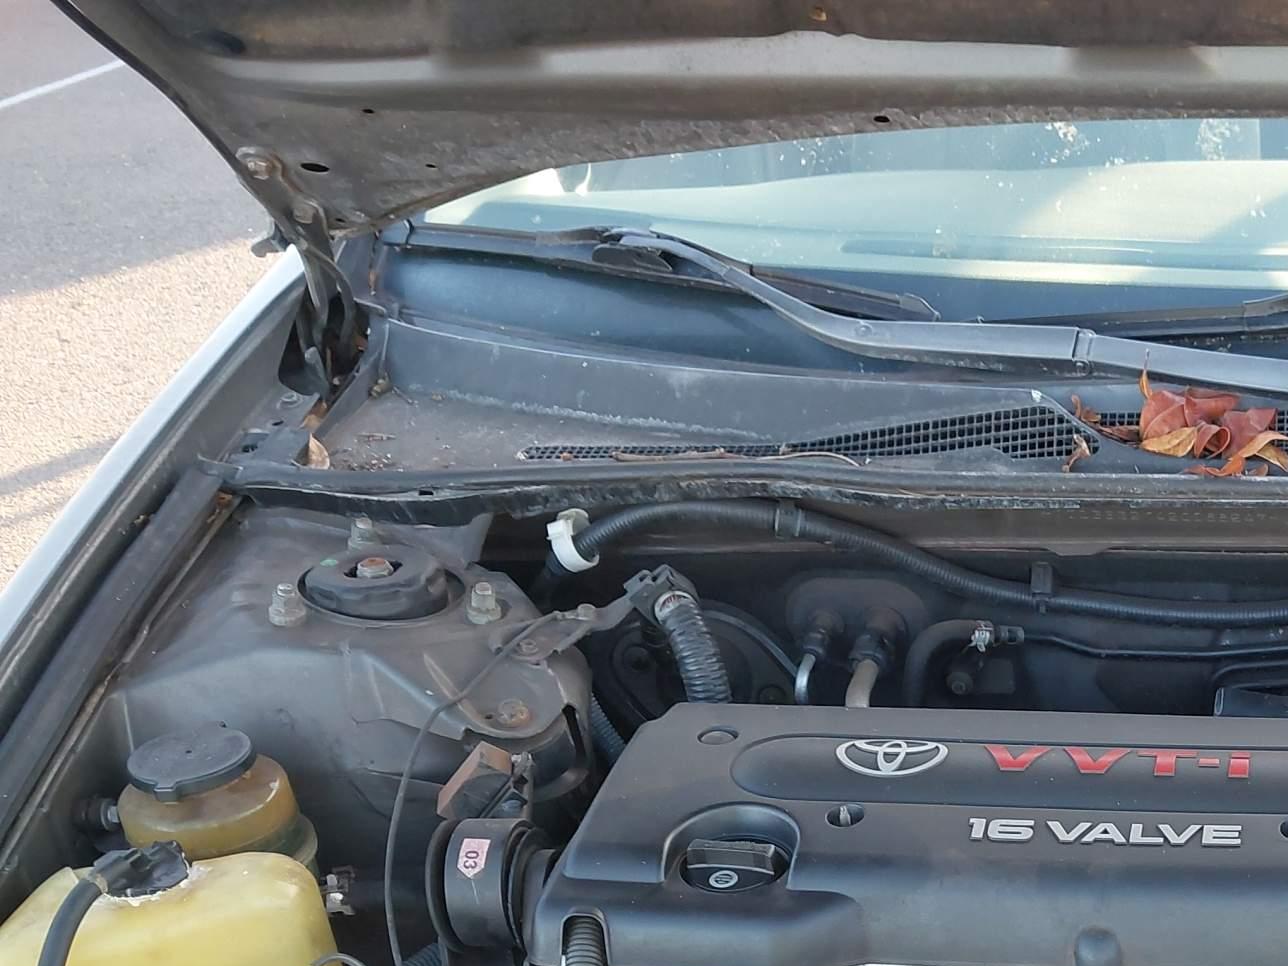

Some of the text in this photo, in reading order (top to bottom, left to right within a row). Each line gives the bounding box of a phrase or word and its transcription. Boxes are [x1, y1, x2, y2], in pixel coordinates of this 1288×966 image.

[968, 816, 1243, 848] 16 VALVE
[463, 850, 479, 869] 03
